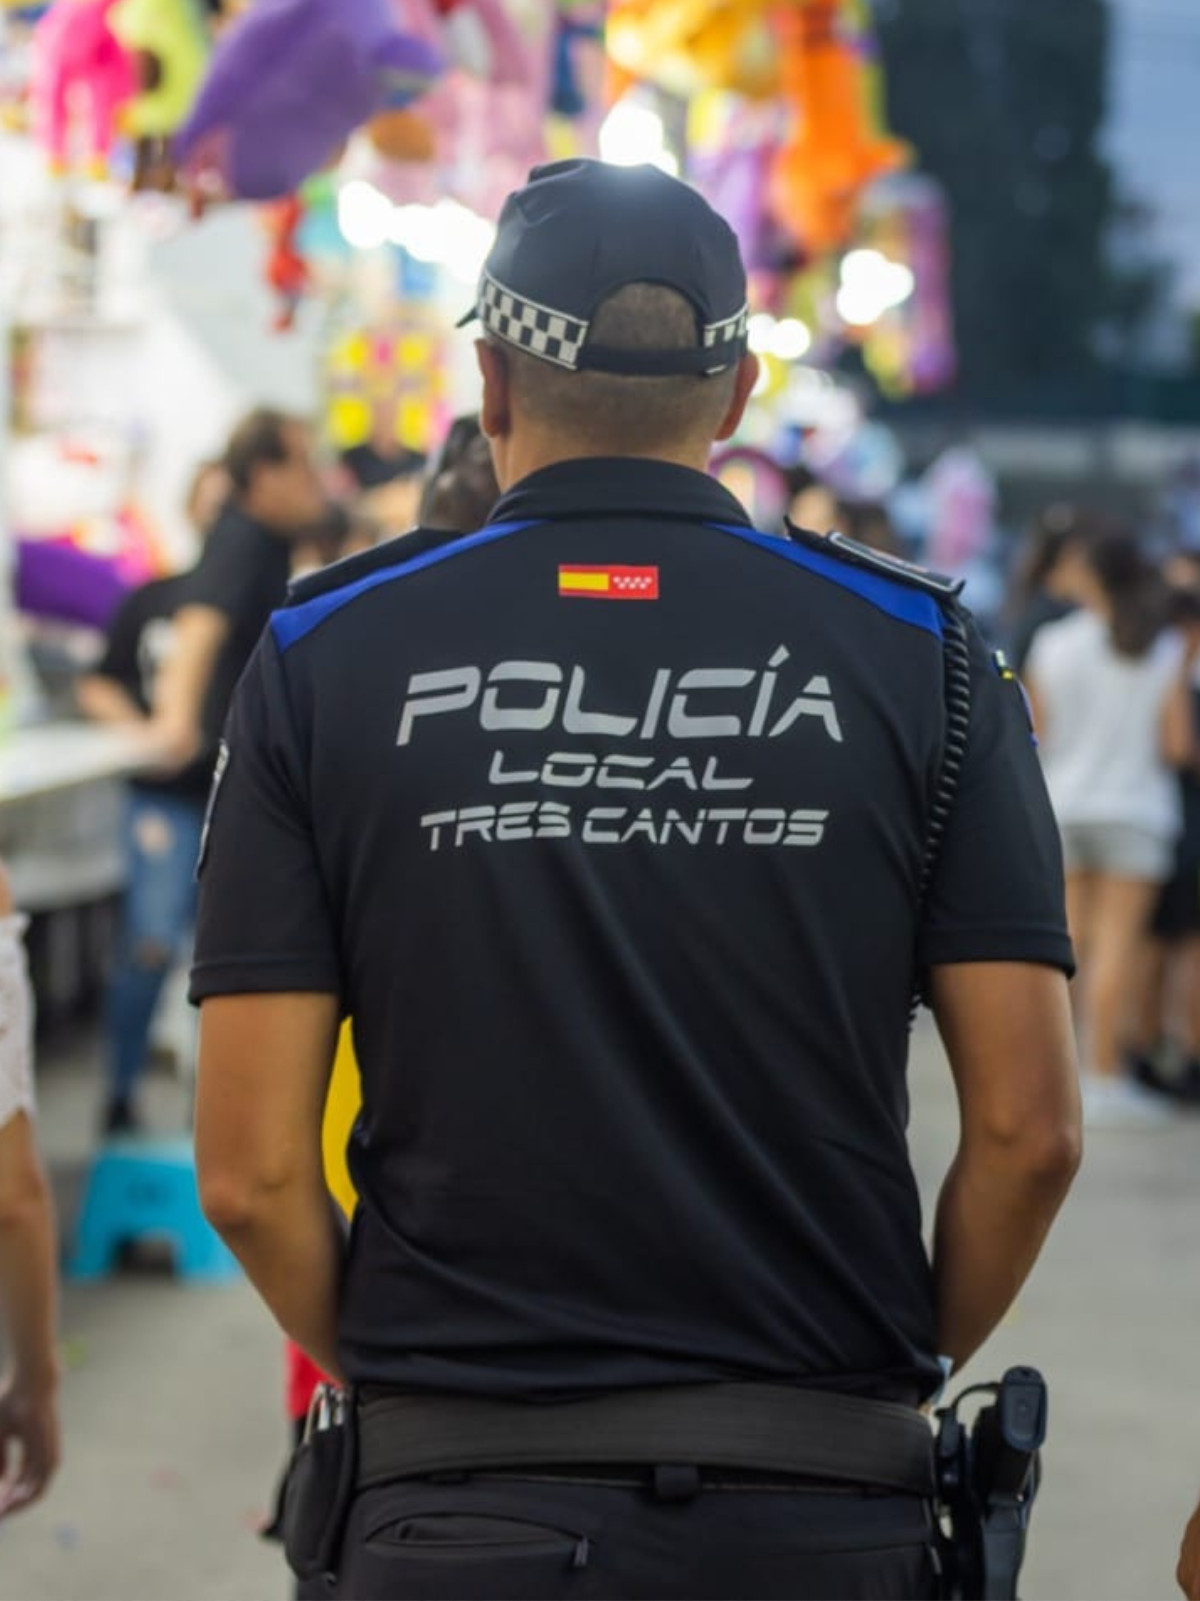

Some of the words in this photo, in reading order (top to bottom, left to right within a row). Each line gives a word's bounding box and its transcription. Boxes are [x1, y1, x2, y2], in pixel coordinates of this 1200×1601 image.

[396, 645, 843, 746] POLICÍA
[488, 750, 753, 790] LOCAL
[420, 801, 571, 851] TRES
[581, 807, 829, 846] CANTOS
